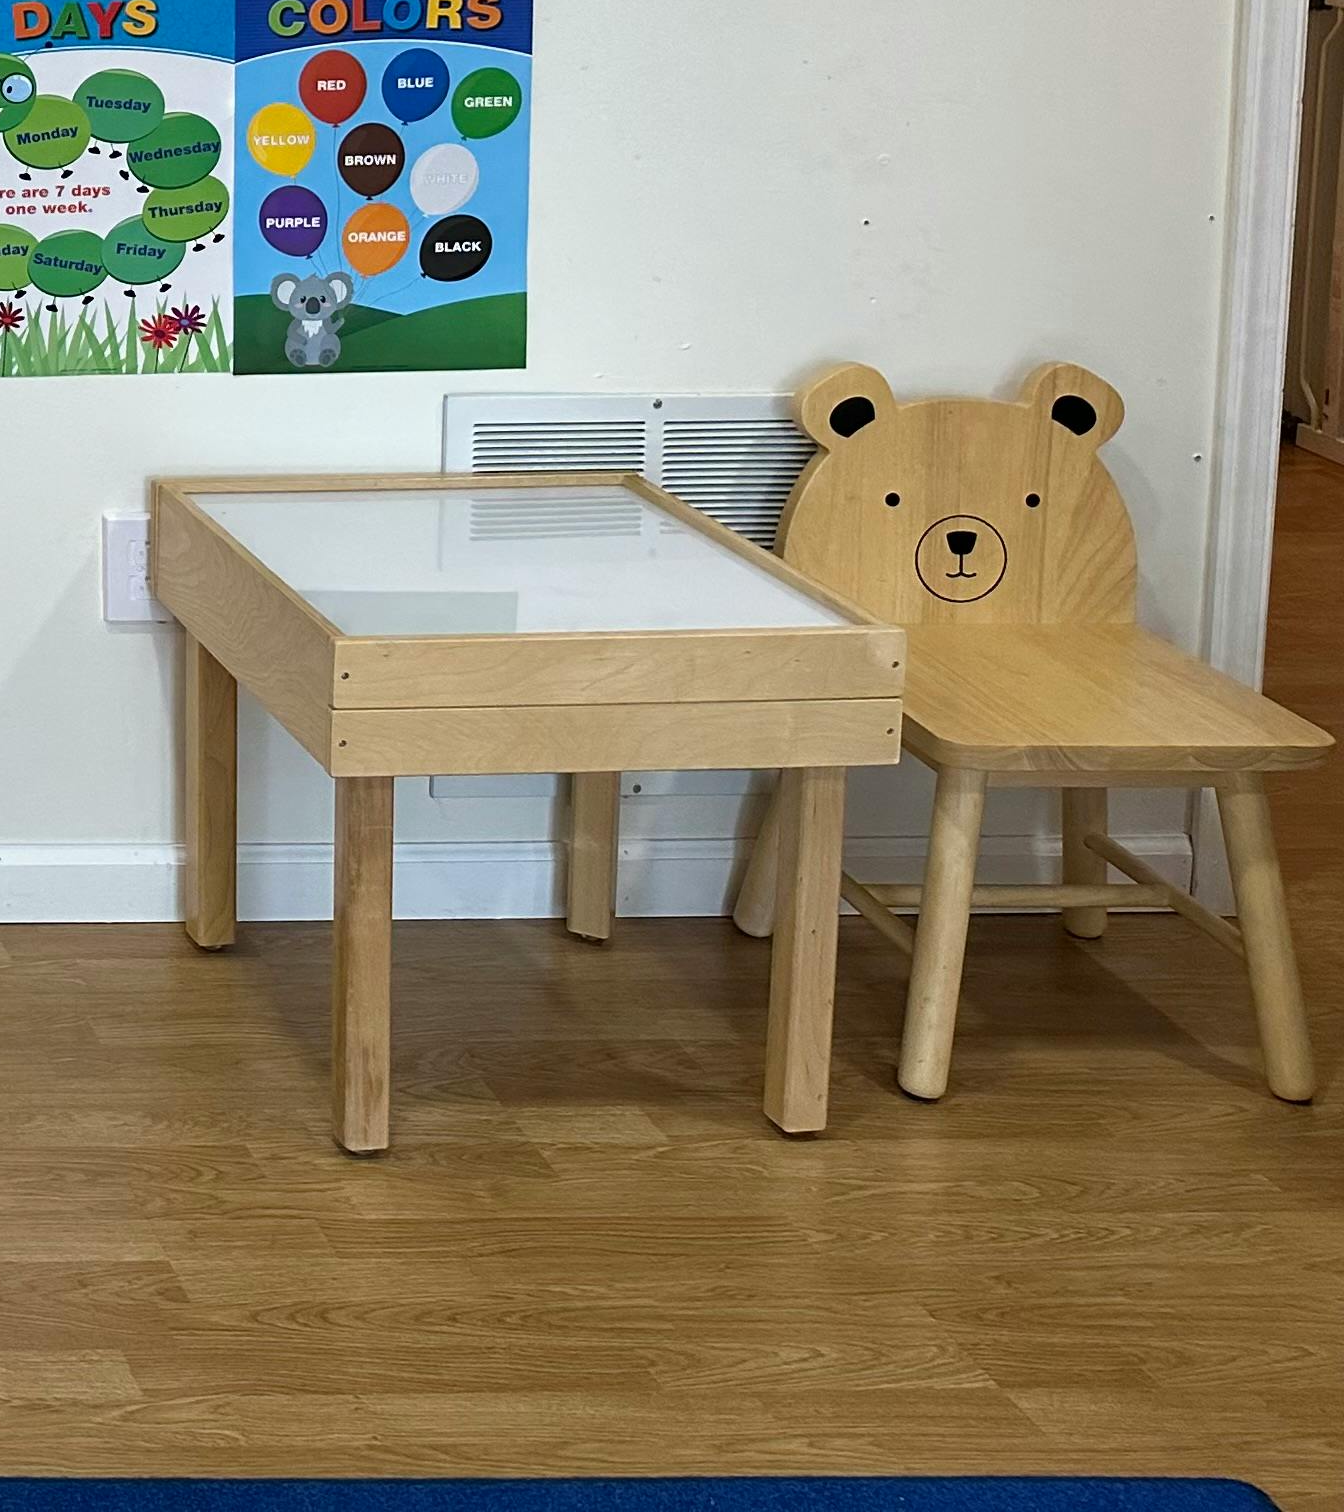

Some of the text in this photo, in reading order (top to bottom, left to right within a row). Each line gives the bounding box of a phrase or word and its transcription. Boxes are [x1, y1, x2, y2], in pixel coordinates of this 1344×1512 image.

[317, 77, 433, 91] RED BLUE
[86, 96, 151, 113] Tuesday
[464, 96, 513, 108] GREEN
[16, 125, 78, 145] Monday
[253, 134, 310, 146] YELLOW
[345, 154, 396, 166] BROWN
[265, 217, 320, 229] PURPLE
[347, 231, 406, 243] ORANGE
[115, 243, 166, 259] Friday
[434, 241, 482, 253] BLACK
